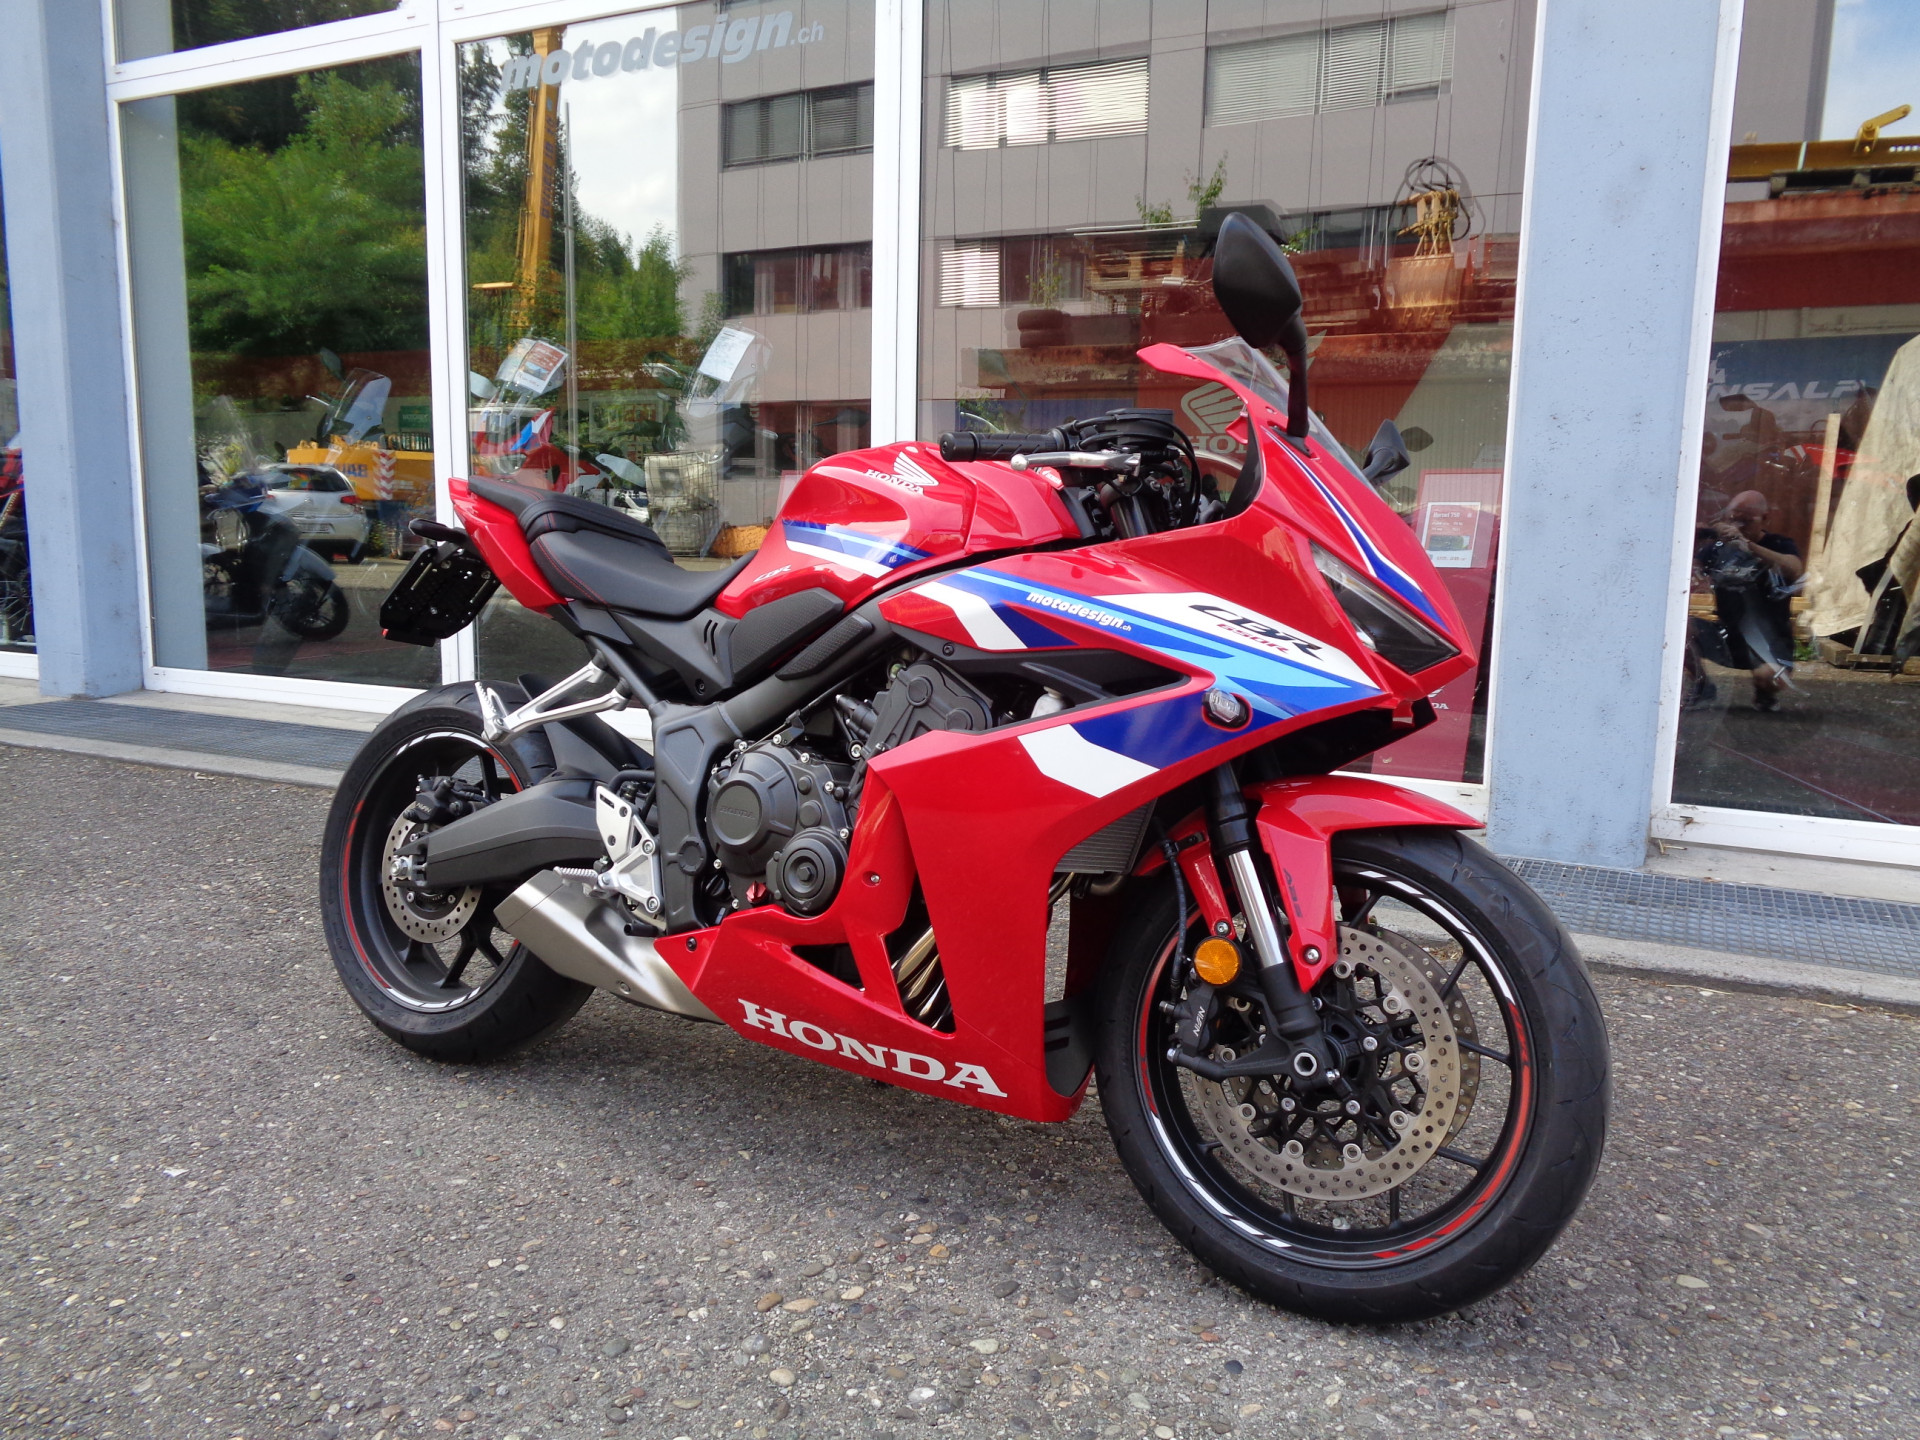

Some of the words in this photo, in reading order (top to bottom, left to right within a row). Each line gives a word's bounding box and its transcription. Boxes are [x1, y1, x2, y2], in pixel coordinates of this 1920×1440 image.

[501, 10, 824, 91] motodesign.ch
[1707, 379, 1868, 401] NSALP
[863, 468, 924, 495] HONDA
[753, 564, 792, 583] CBR
[1026, 591, 1132, 632] motodesign.ch
[1188, 604, 1324, 662] CBR
[1215, 623, 1290, 655] 650R
[737, 998, 1008, 1098] HONDA
